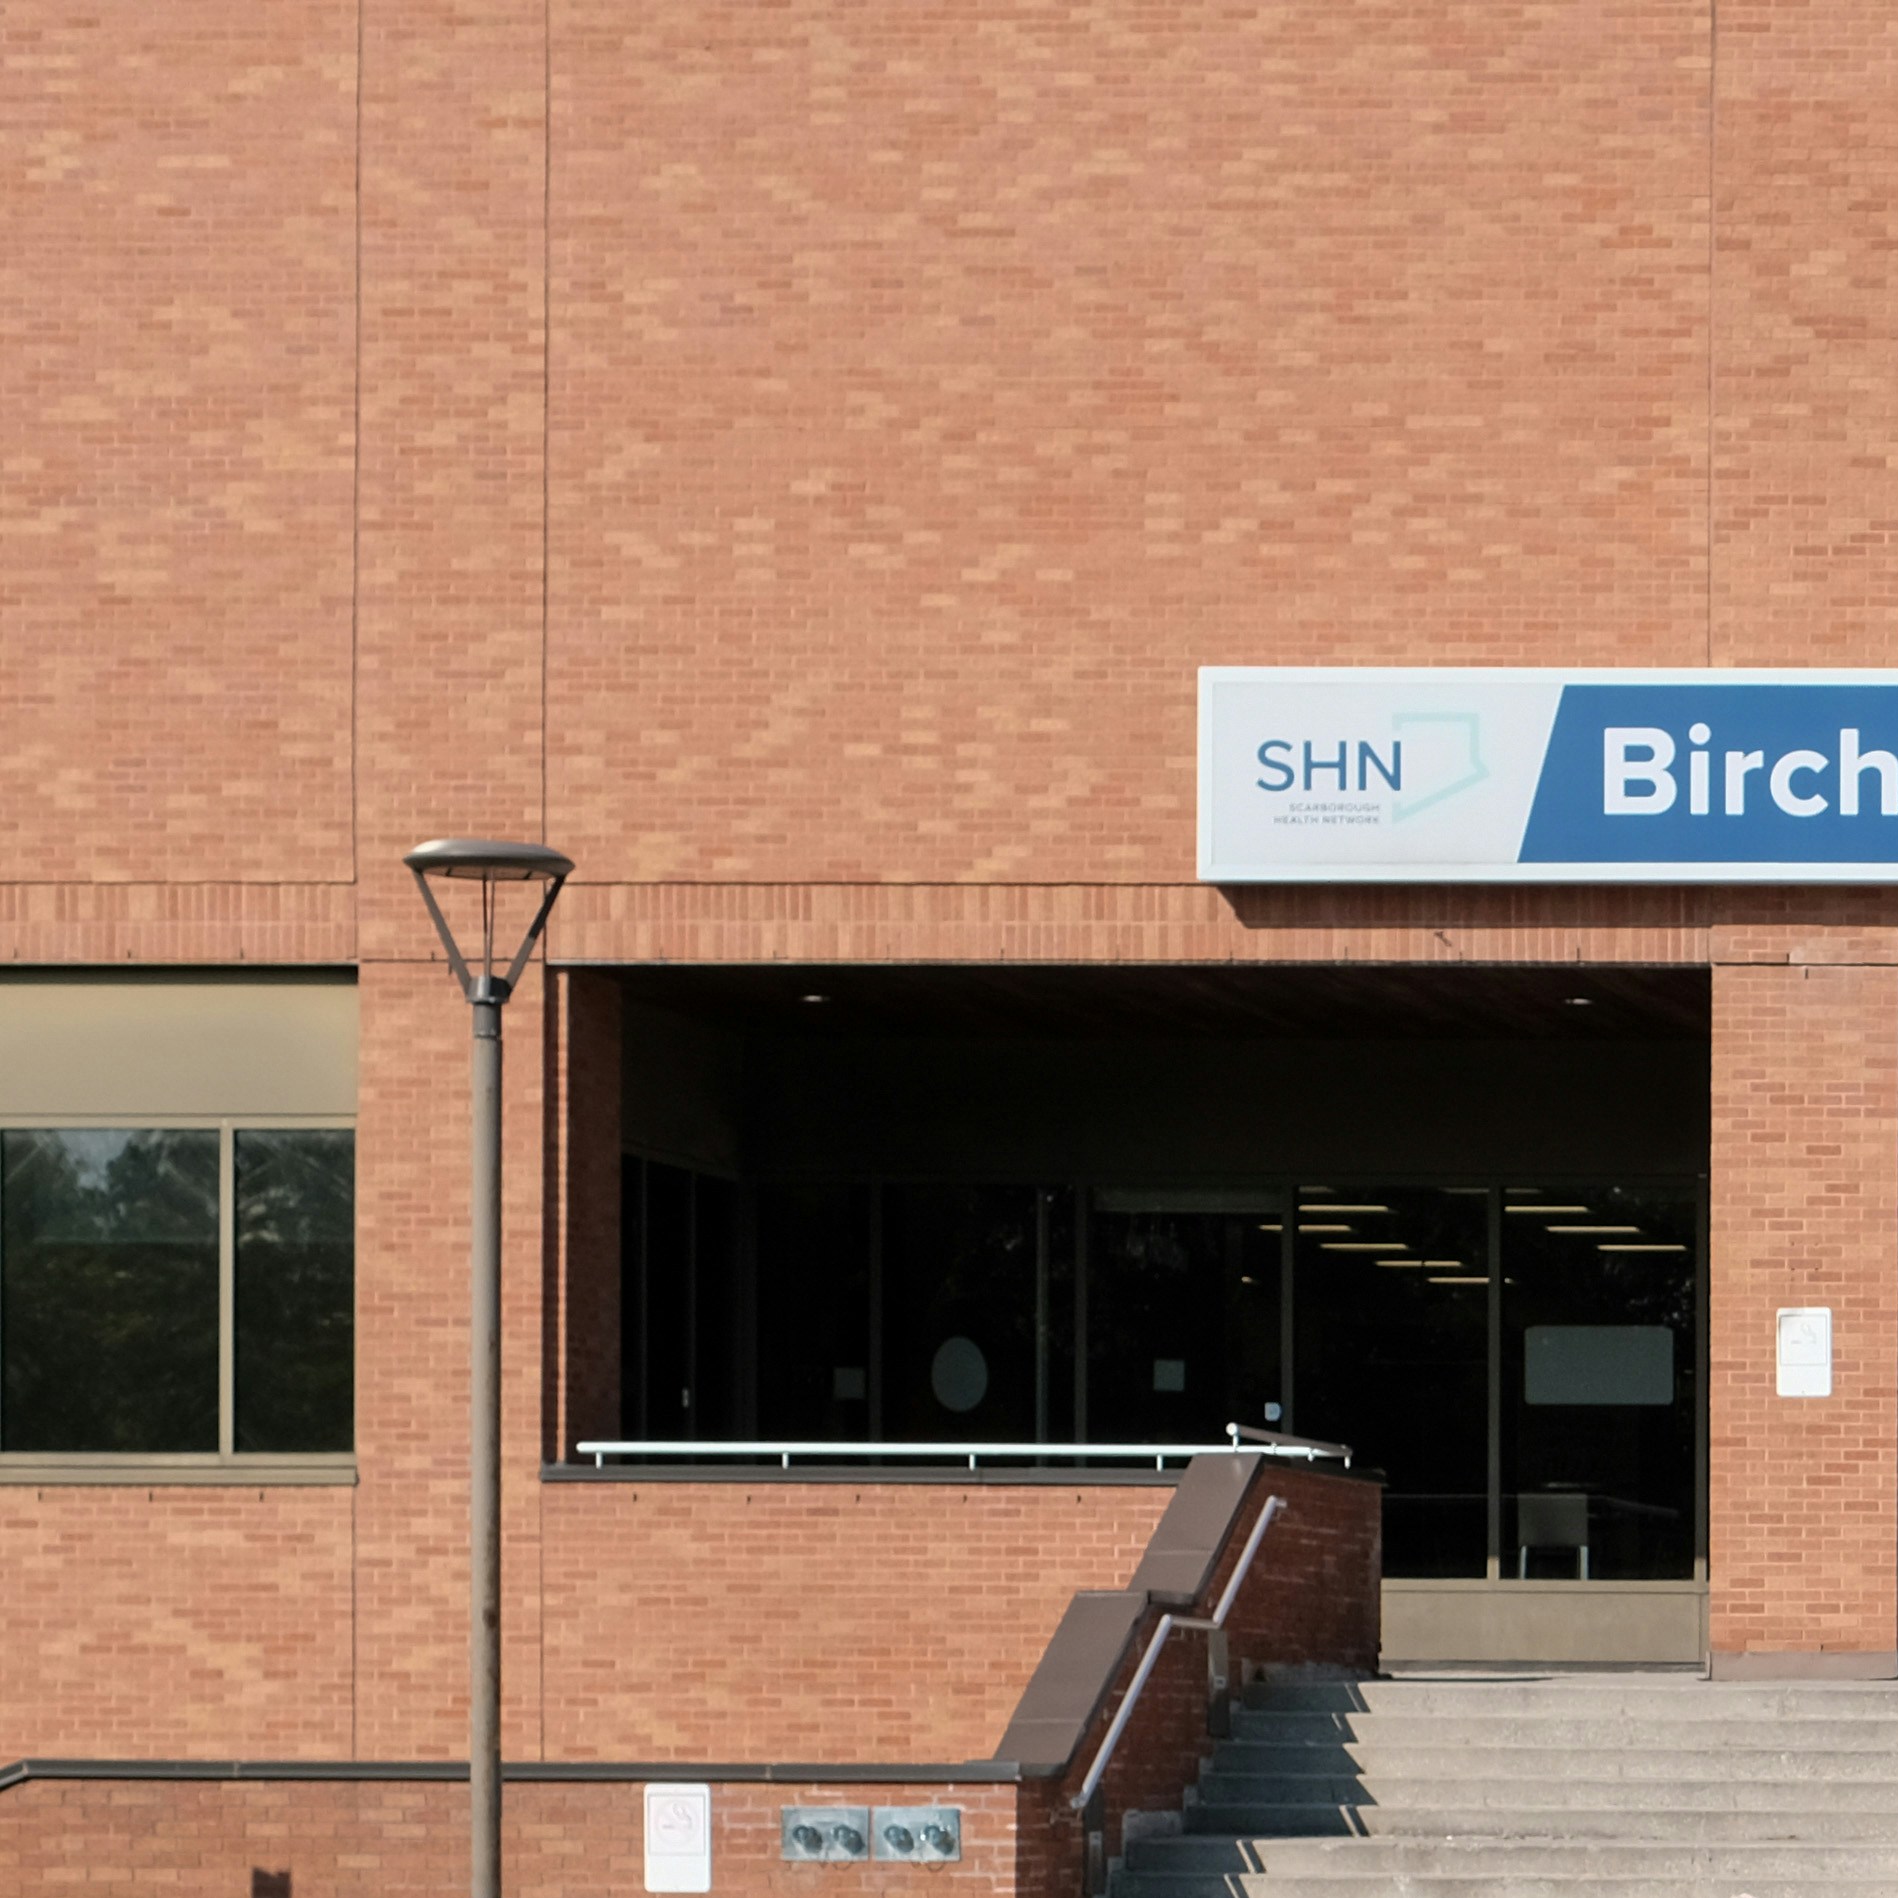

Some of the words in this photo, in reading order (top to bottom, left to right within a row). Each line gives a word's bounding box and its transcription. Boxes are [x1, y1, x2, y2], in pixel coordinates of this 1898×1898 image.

[1257, 740, 1401, 791] SHN
[1289, 802, 1380, 812] SCARBOROUGH
[1273, 815, 1319, 824] HEALTH
[1322, 815, 1379, 824] NETWORK
